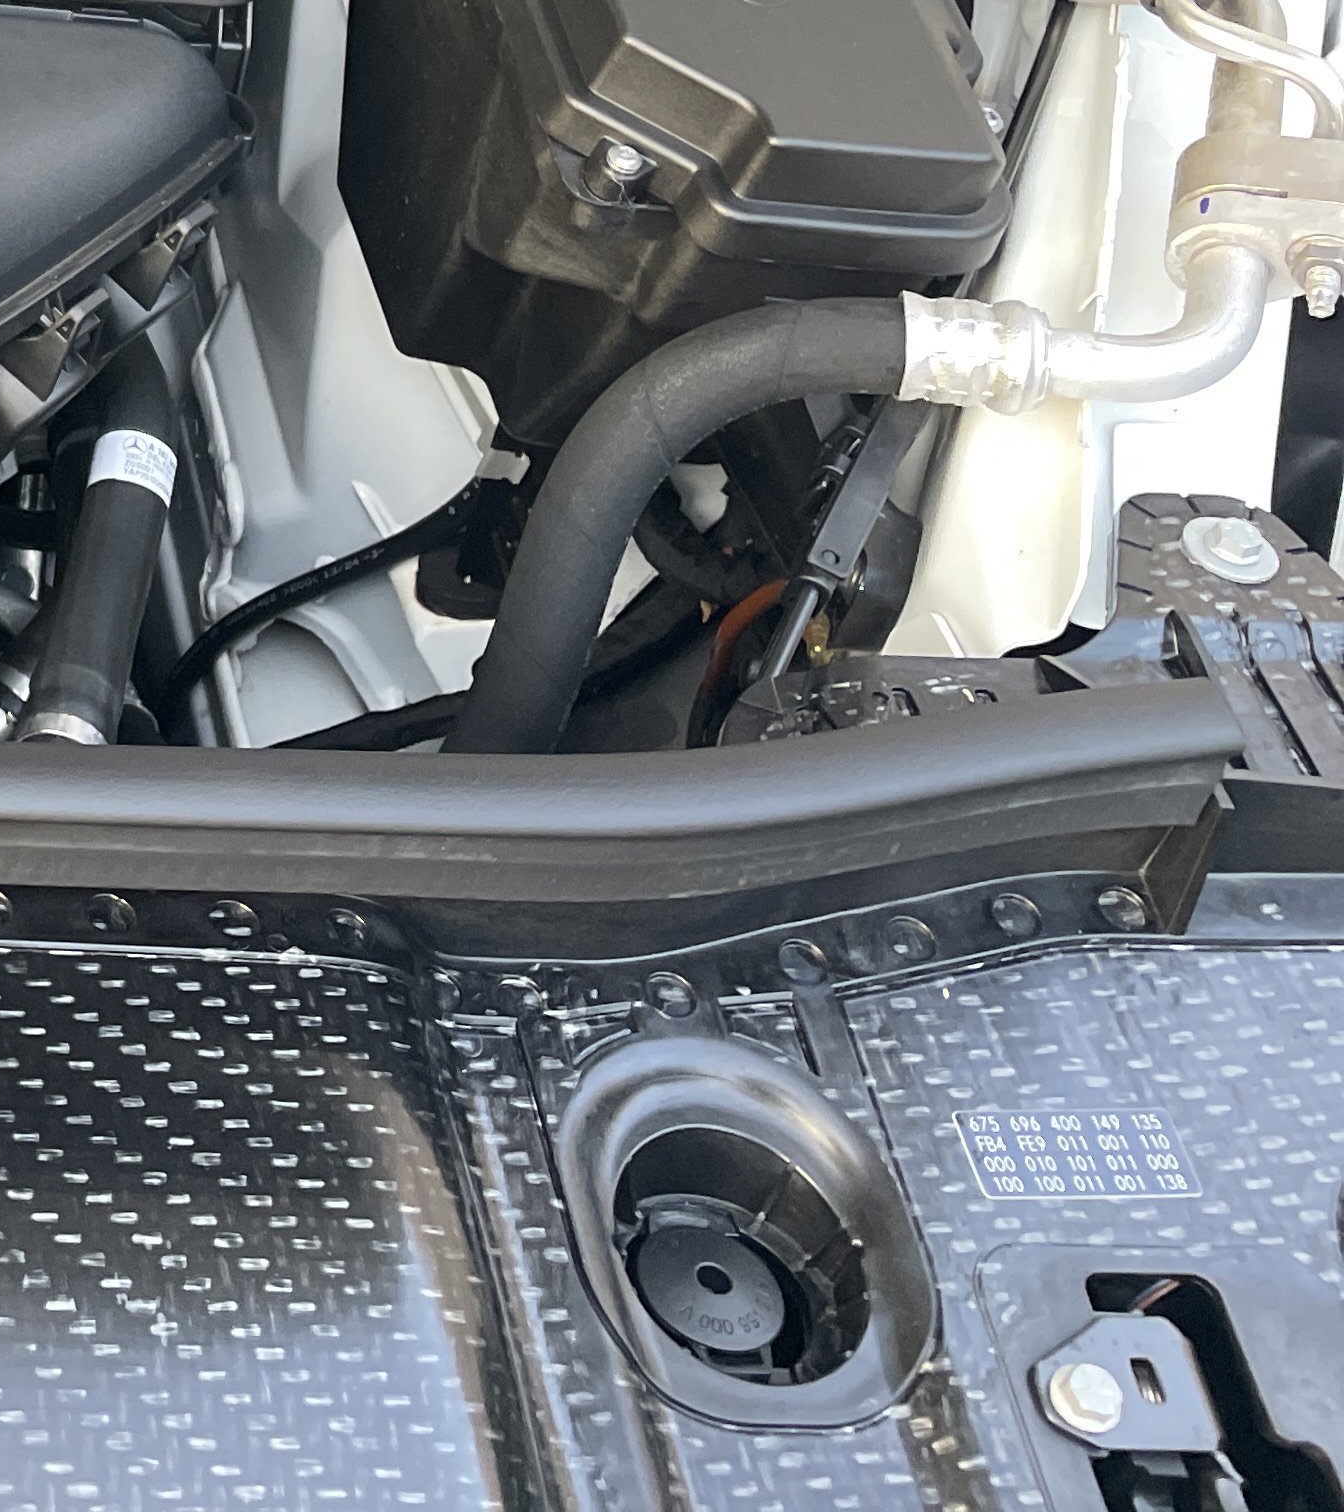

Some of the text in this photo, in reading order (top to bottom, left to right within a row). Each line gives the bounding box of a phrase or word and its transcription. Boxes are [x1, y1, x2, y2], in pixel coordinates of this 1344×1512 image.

[969, 1113, 1162, 1132] 675 696 400 149 135
[1016, 1135, 1046, 1152] FE9
[1056, 1135, 1089, 1151] 011
[1097, 1134, 1129, 1151] 001
[1139, 1133, 1170, 1150] 110
[983, 1153, 1179, 1173] 000 010 101 011 000
[993, 1174, 1188, 1193] 100 100 011 001 138
